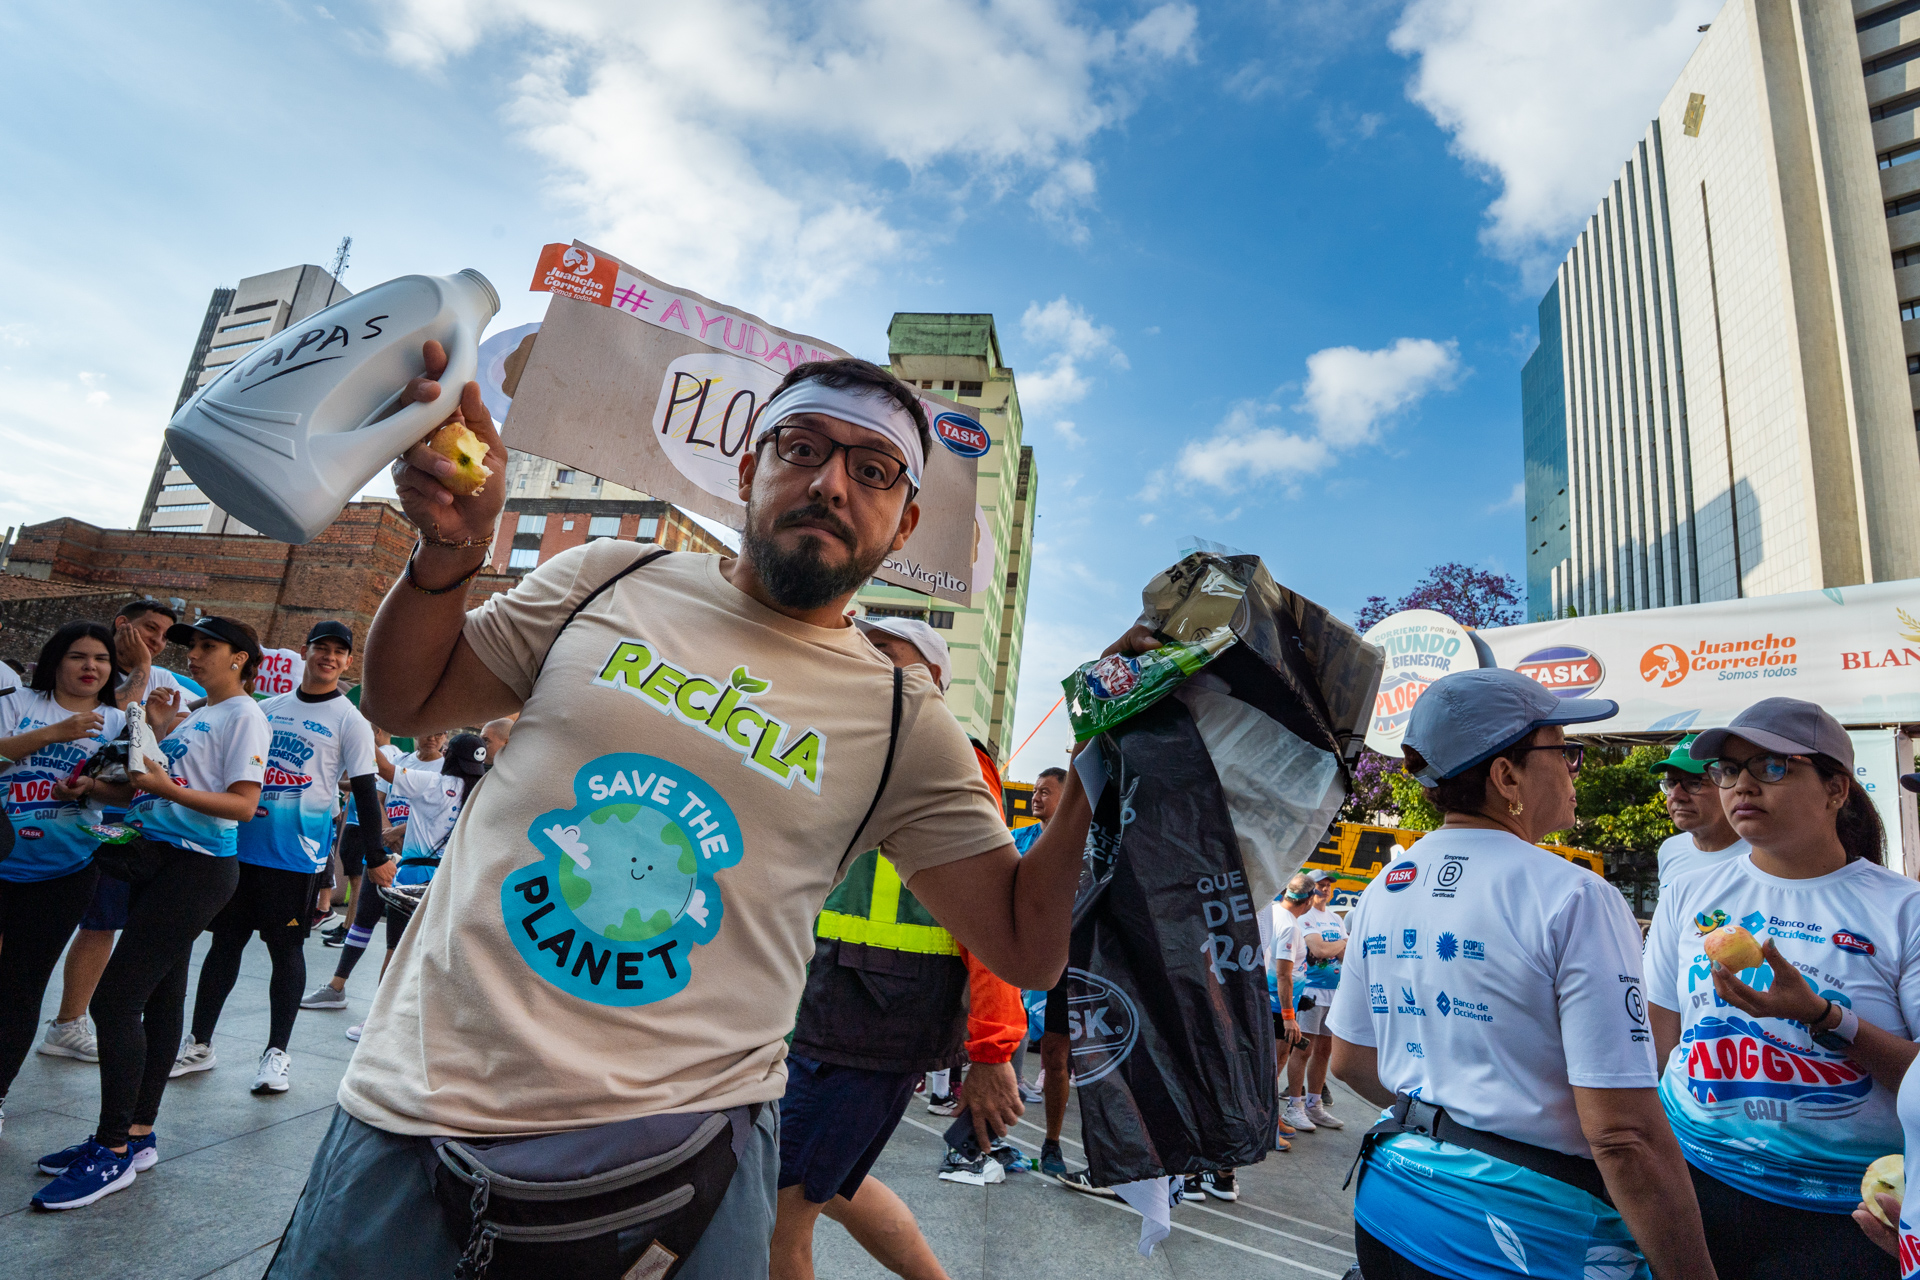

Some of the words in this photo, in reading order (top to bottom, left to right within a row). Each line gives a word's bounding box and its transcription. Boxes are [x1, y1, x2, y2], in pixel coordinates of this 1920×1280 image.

[543, 276, 602, 299] Correlón
[546, 266, 603, 290] Juancho
[549, 286, 572, 298] Somos
[573, 293, 592, 302] todos
[942, 423, 981, 446] TASK
[1374, 625, 1428, 642] CORRIENDO
[1447, 628, 1458, 636] UN
[1690, 633, 1797, 656] Juancho
[1392, 654, 1451, 671] BIENESTAR
[1691, 648, 1798, 672] Correlón
[1520, 663, 1590, 684] TASK
[1717, 668, 1759, 682] Somos
[1762, 666, 1798, 679] todos
[599, 640, 823, 785] RECICLA
[34, 809, 59, 820] CALI
[588, 769, 678, 806] SAVE
[678, 791, 730, 860] THE
[20, 829, 42, 838] TASK
[1197, 870, 1244, 894] QUE
[1389, 870, 1413, 882] TASK
[1202, 893, 1254, 928] DE
[514, 875, 678, 990] PLANET
[1769, 915, 1805, 929] Banco
[1807, 922, 1823, 932] de
[1767, 926, 1827, 945] Occidente
[1837, 934, 1869, 951] TASK
[1463, 940, 1485, 952] COP16
[1792, 961, 1819, 977] POR
[1824, 973, 1845, 989] UN
[1453, 997, 1475, 1010] Banco
[1476, 1003, 1489, 1012] de
[1692, 992, 1710, 1009] DE
[1453, 1007, 1494, 1023] Occidente
[1743, 1099, 1788, 1122] CALI
